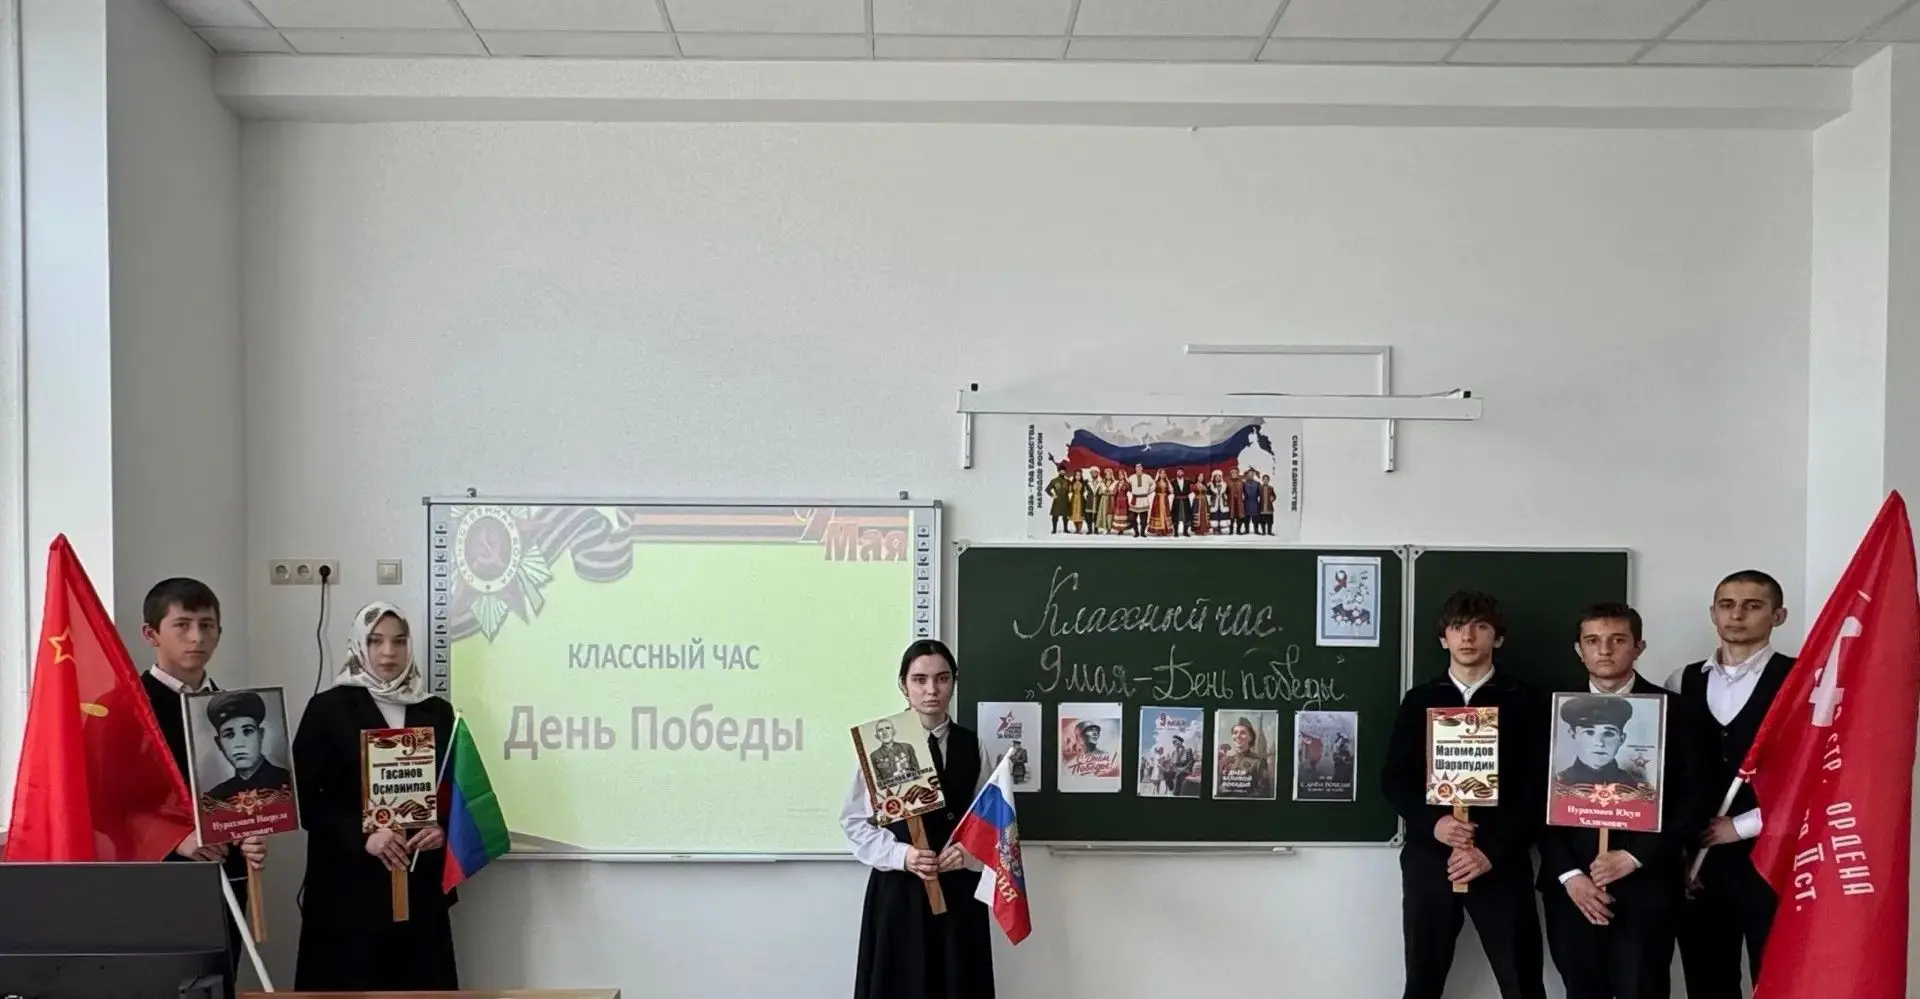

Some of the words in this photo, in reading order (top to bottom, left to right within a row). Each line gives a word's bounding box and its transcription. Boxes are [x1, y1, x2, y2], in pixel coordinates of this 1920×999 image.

[1027, 424, 1035, 470] ЕДИНСТВА
[1027, 470, 1035, 488] ГОД
[825, 521, 908, 562] Мая
[1013, 565, 1211, 639] Классный
[568, 637, 705, 670] КЛАССНЫЙ
[712, 644, 761, 670] ЧАС
[503, 704, 616, 761] День
[630, 702, 804, 761] Победы
[1159, 711, 1167, 727] 9
[1434, 758, 1495, 772] Шарапудин
[1435, 744, 1495, 758] Магомедов
[380, 767, 424, 780] Гасанов
[1826, 801, 1875, 896] ОРДЕНА
